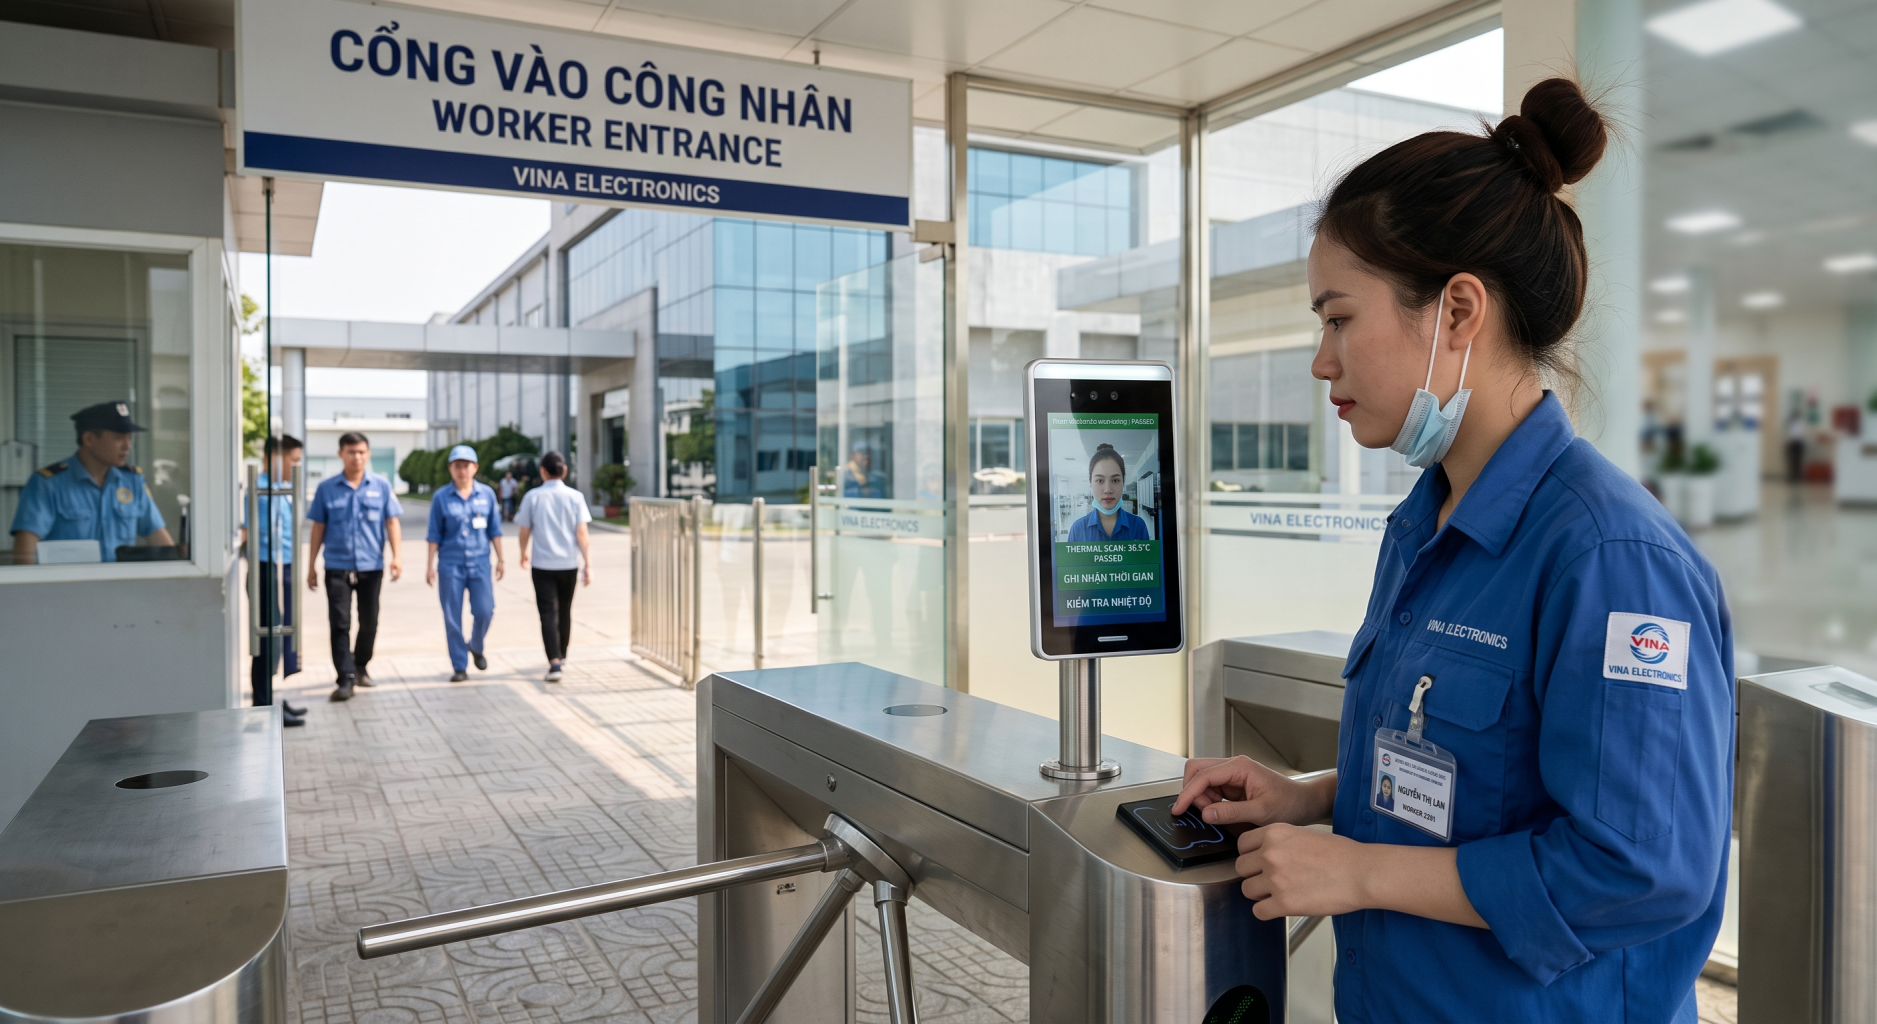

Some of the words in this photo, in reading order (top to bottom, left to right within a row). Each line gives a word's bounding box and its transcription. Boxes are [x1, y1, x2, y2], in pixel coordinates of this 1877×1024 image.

[330, 20, 476, 86] CỔNG
[491, 43, 589, 100] VÀO
[604, 60, 726, 117] CÔNG
[740, 83, 853, 134] NHÂN
[432, 98, 593, 148] WORKER
[604, 118, 783, 168] ENTRANCE
[512, 165, 570, 190] VINA
[575, 171, 721, 204] ELECTRONICS
[861, 516, 919, 533] ELECTRONICS
[1249, 511, 1282, 526] VINA
[1065, 545, 1103, 553] THERMAL
[1103, 544, 1127, 553] SCAN:
[1093, 554, 1123, 563] PASSED
[1063, 574, 1079, 584] GHI
[1081, 571, 1108, 585] NHẬN
[1132, 571, 1154, 581] GIAN
[1091, 598, 1110, 608] TRA
[1111, 595, 1137, 608] NHIỆT
[1138, 594, 1152, 608] ĐỘ
[1426, 619, 1446, 634] VINA
[1445, 623, 1508, 650] ELECTRONICS
[1630, 635, 1670, 652] VINA
[1608, 665, 1630, 675] VINA
[1631, 667, 1682, 683] ELECTRONICS
[1402, 803, 1423, 817] WORKER
[1432, 798, 1446, 811] LAN
